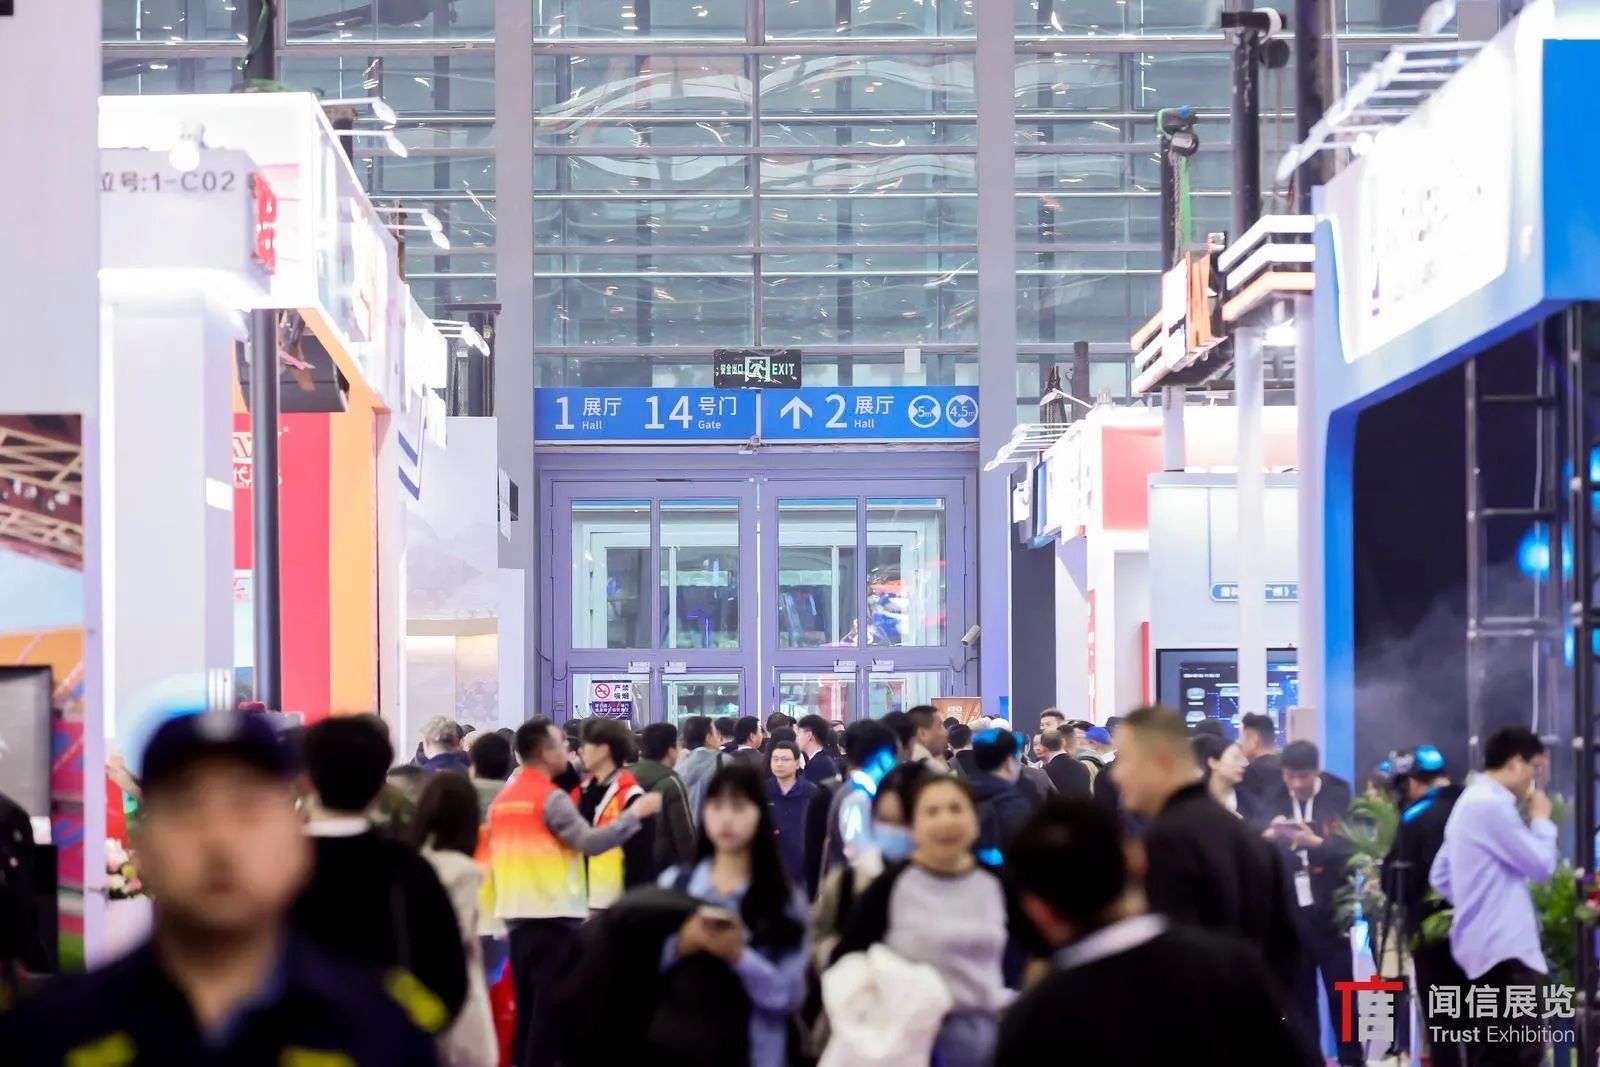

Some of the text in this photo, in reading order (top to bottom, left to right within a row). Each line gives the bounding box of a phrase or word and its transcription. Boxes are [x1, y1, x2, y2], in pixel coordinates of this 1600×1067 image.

[771, 363, 795, 375] EXIT
[555, 396, 622, 430] 1 展厅
[644, 395, 737, 430] 14 号门
[825, 394, 894, 429] 2 展厅
[917, 405, 932, 418] 5m
[949, 405, 976, 418] 4.5m
[582, 420, 603, 430] Hall
[698, 420, 722, 430] Gate
[854, 419, 875, 428] Hall
